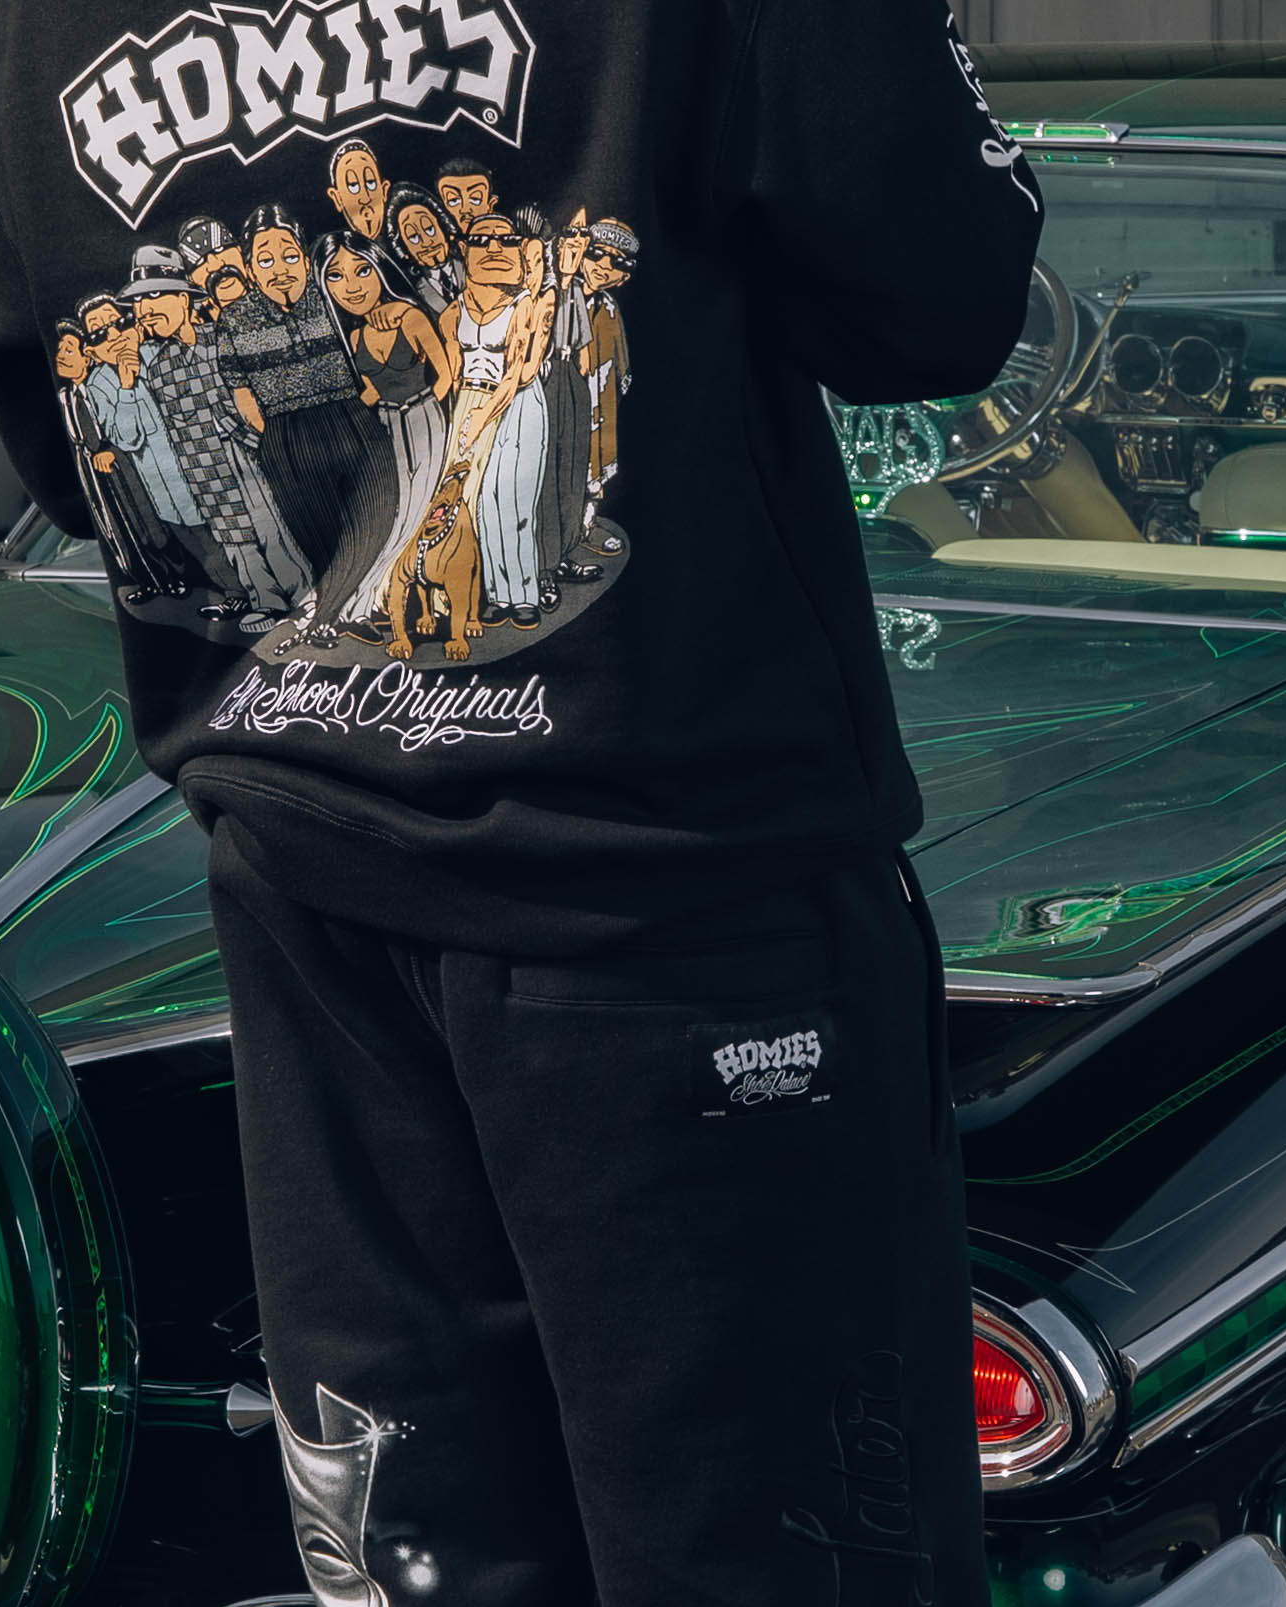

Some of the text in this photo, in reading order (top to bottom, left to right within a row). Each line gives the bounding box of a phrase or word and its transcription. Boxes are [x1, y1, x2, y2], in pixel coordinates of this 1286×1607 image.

[250, 658, 355, 734] School
[356, 660, 553, 752] Originals
[714, 1030, 822, 1085] HOMIES
